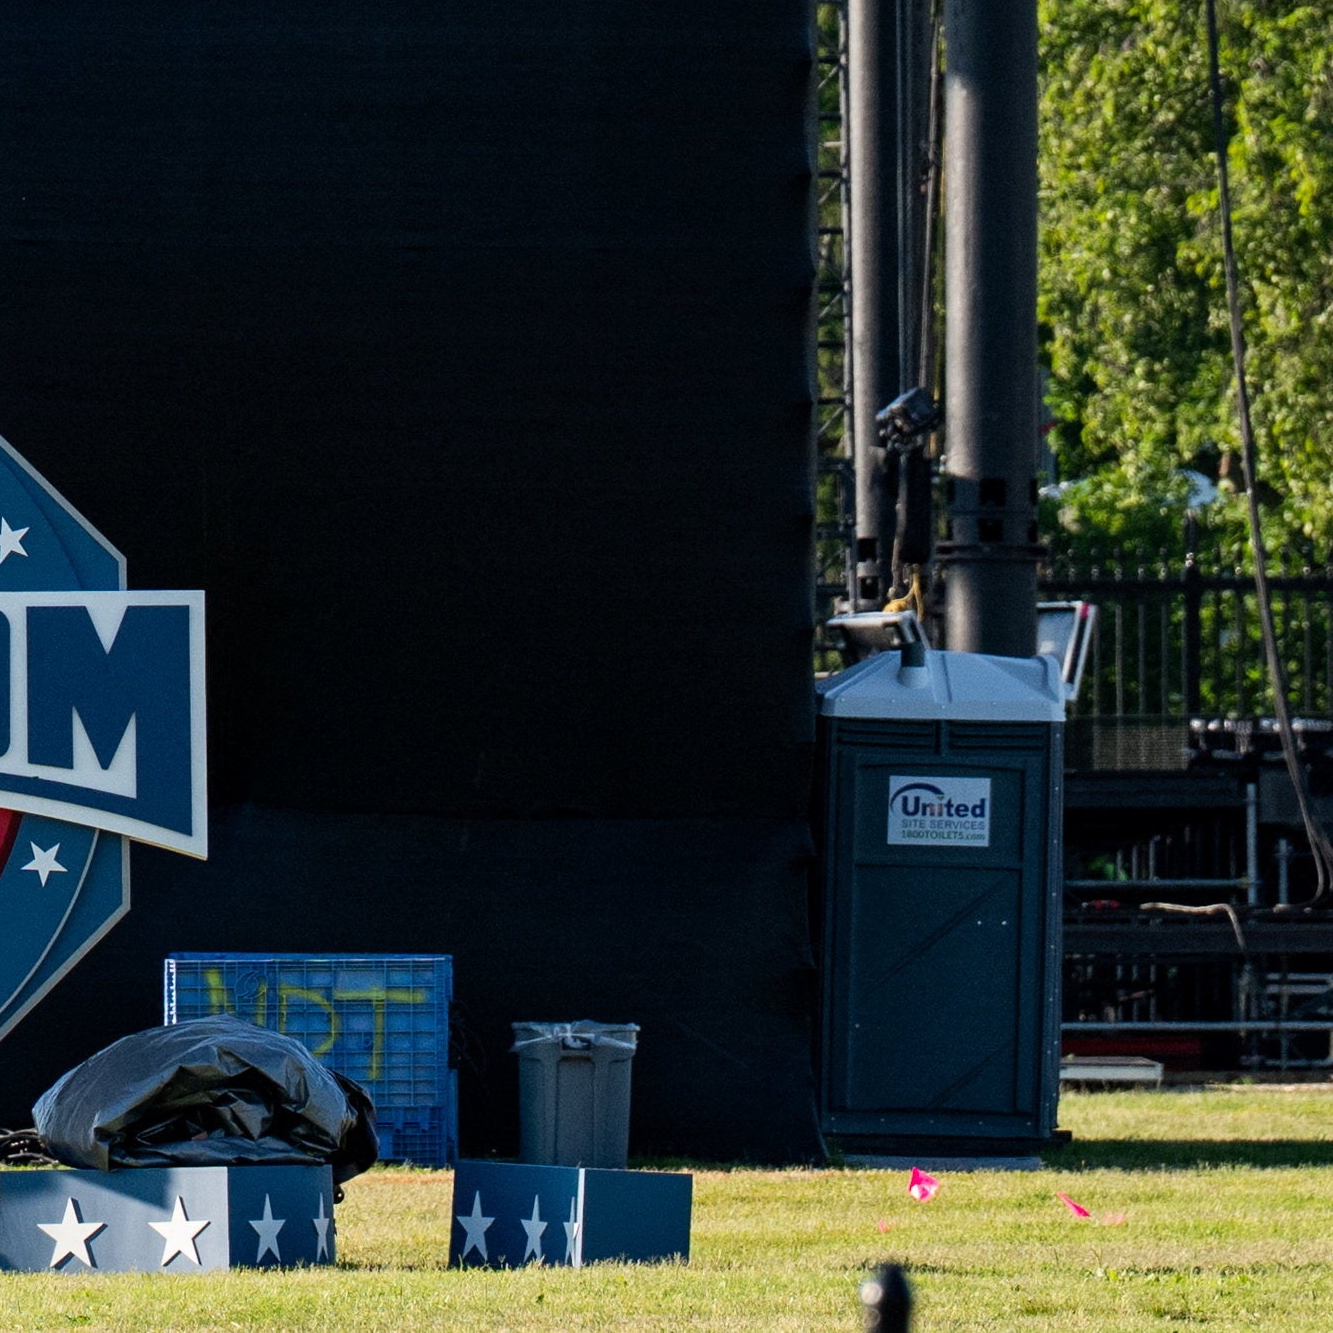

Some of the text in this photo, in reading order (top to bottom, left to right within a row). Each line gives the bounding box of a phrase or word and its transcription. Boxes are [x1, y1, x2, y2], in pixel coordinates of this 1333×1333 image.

[901, 795, 986, 818] United
[901, 819, 985, 831] SITE SERVICES
